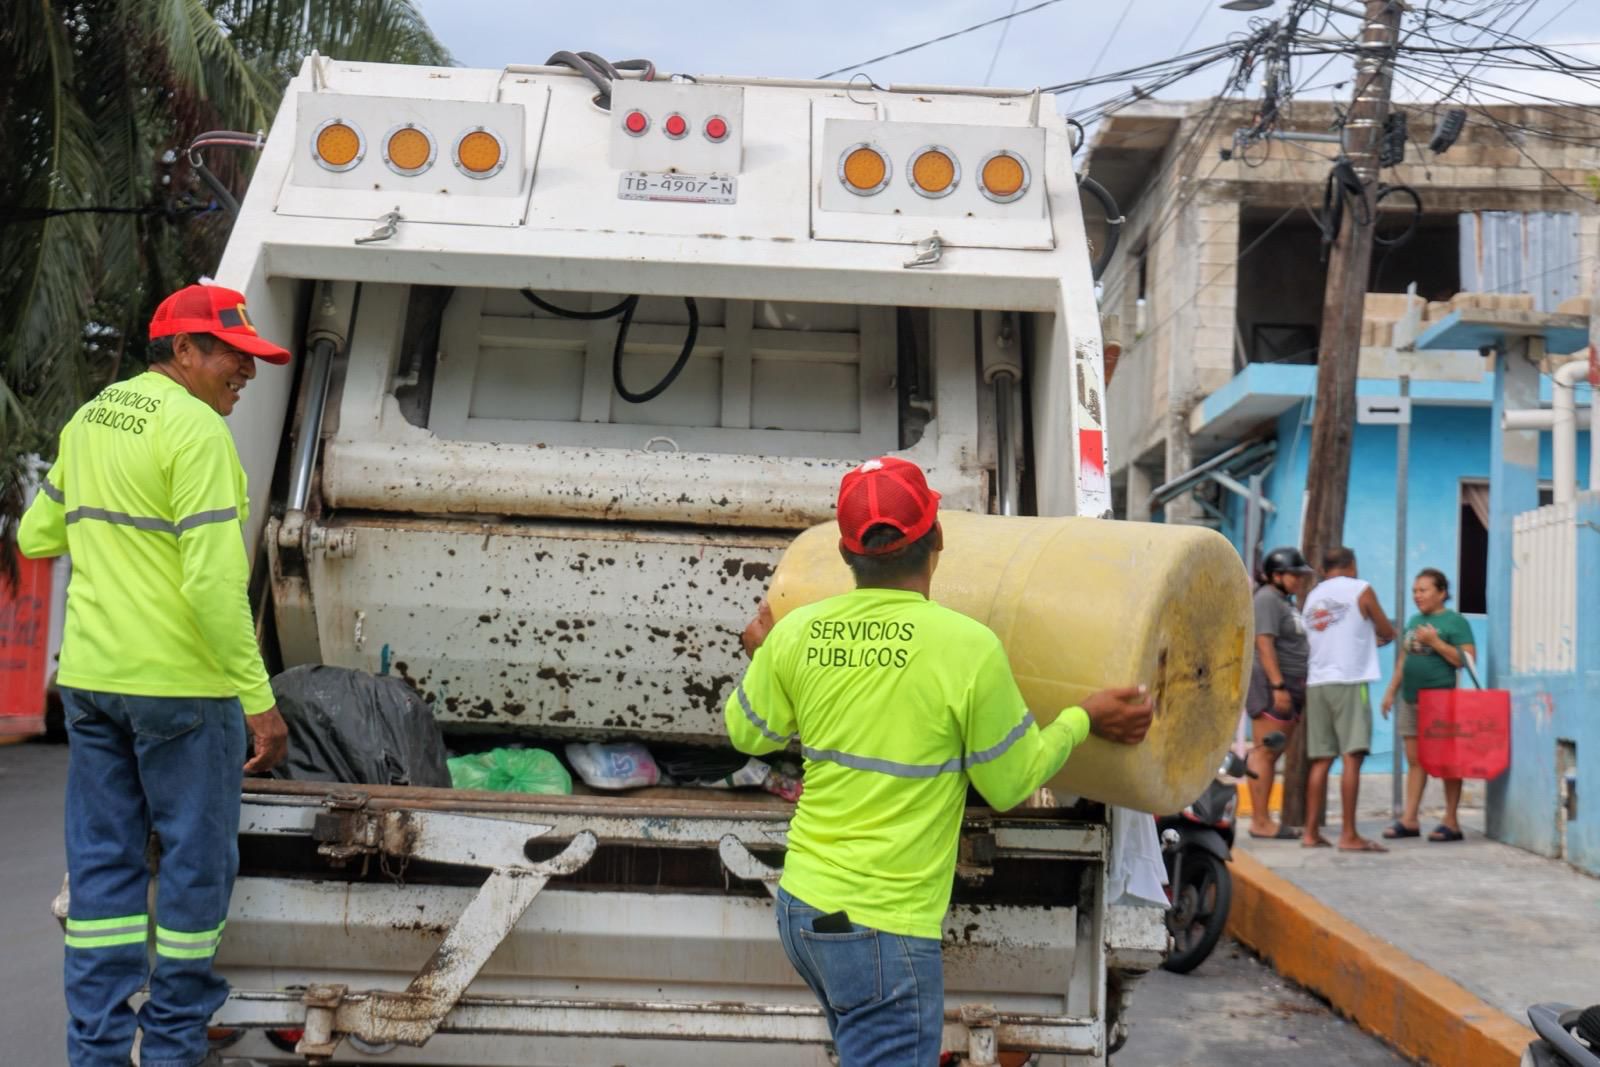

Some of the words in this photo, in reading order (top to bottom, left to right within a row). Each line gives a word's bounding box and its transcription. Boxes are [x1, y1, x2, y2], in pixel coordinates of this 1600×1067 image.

[624, 178, 732, 195] TB-4907-N
[810, 620, 915, 642] SERVICIOS
[806, 641, 908, 668] PÚBLICOS
